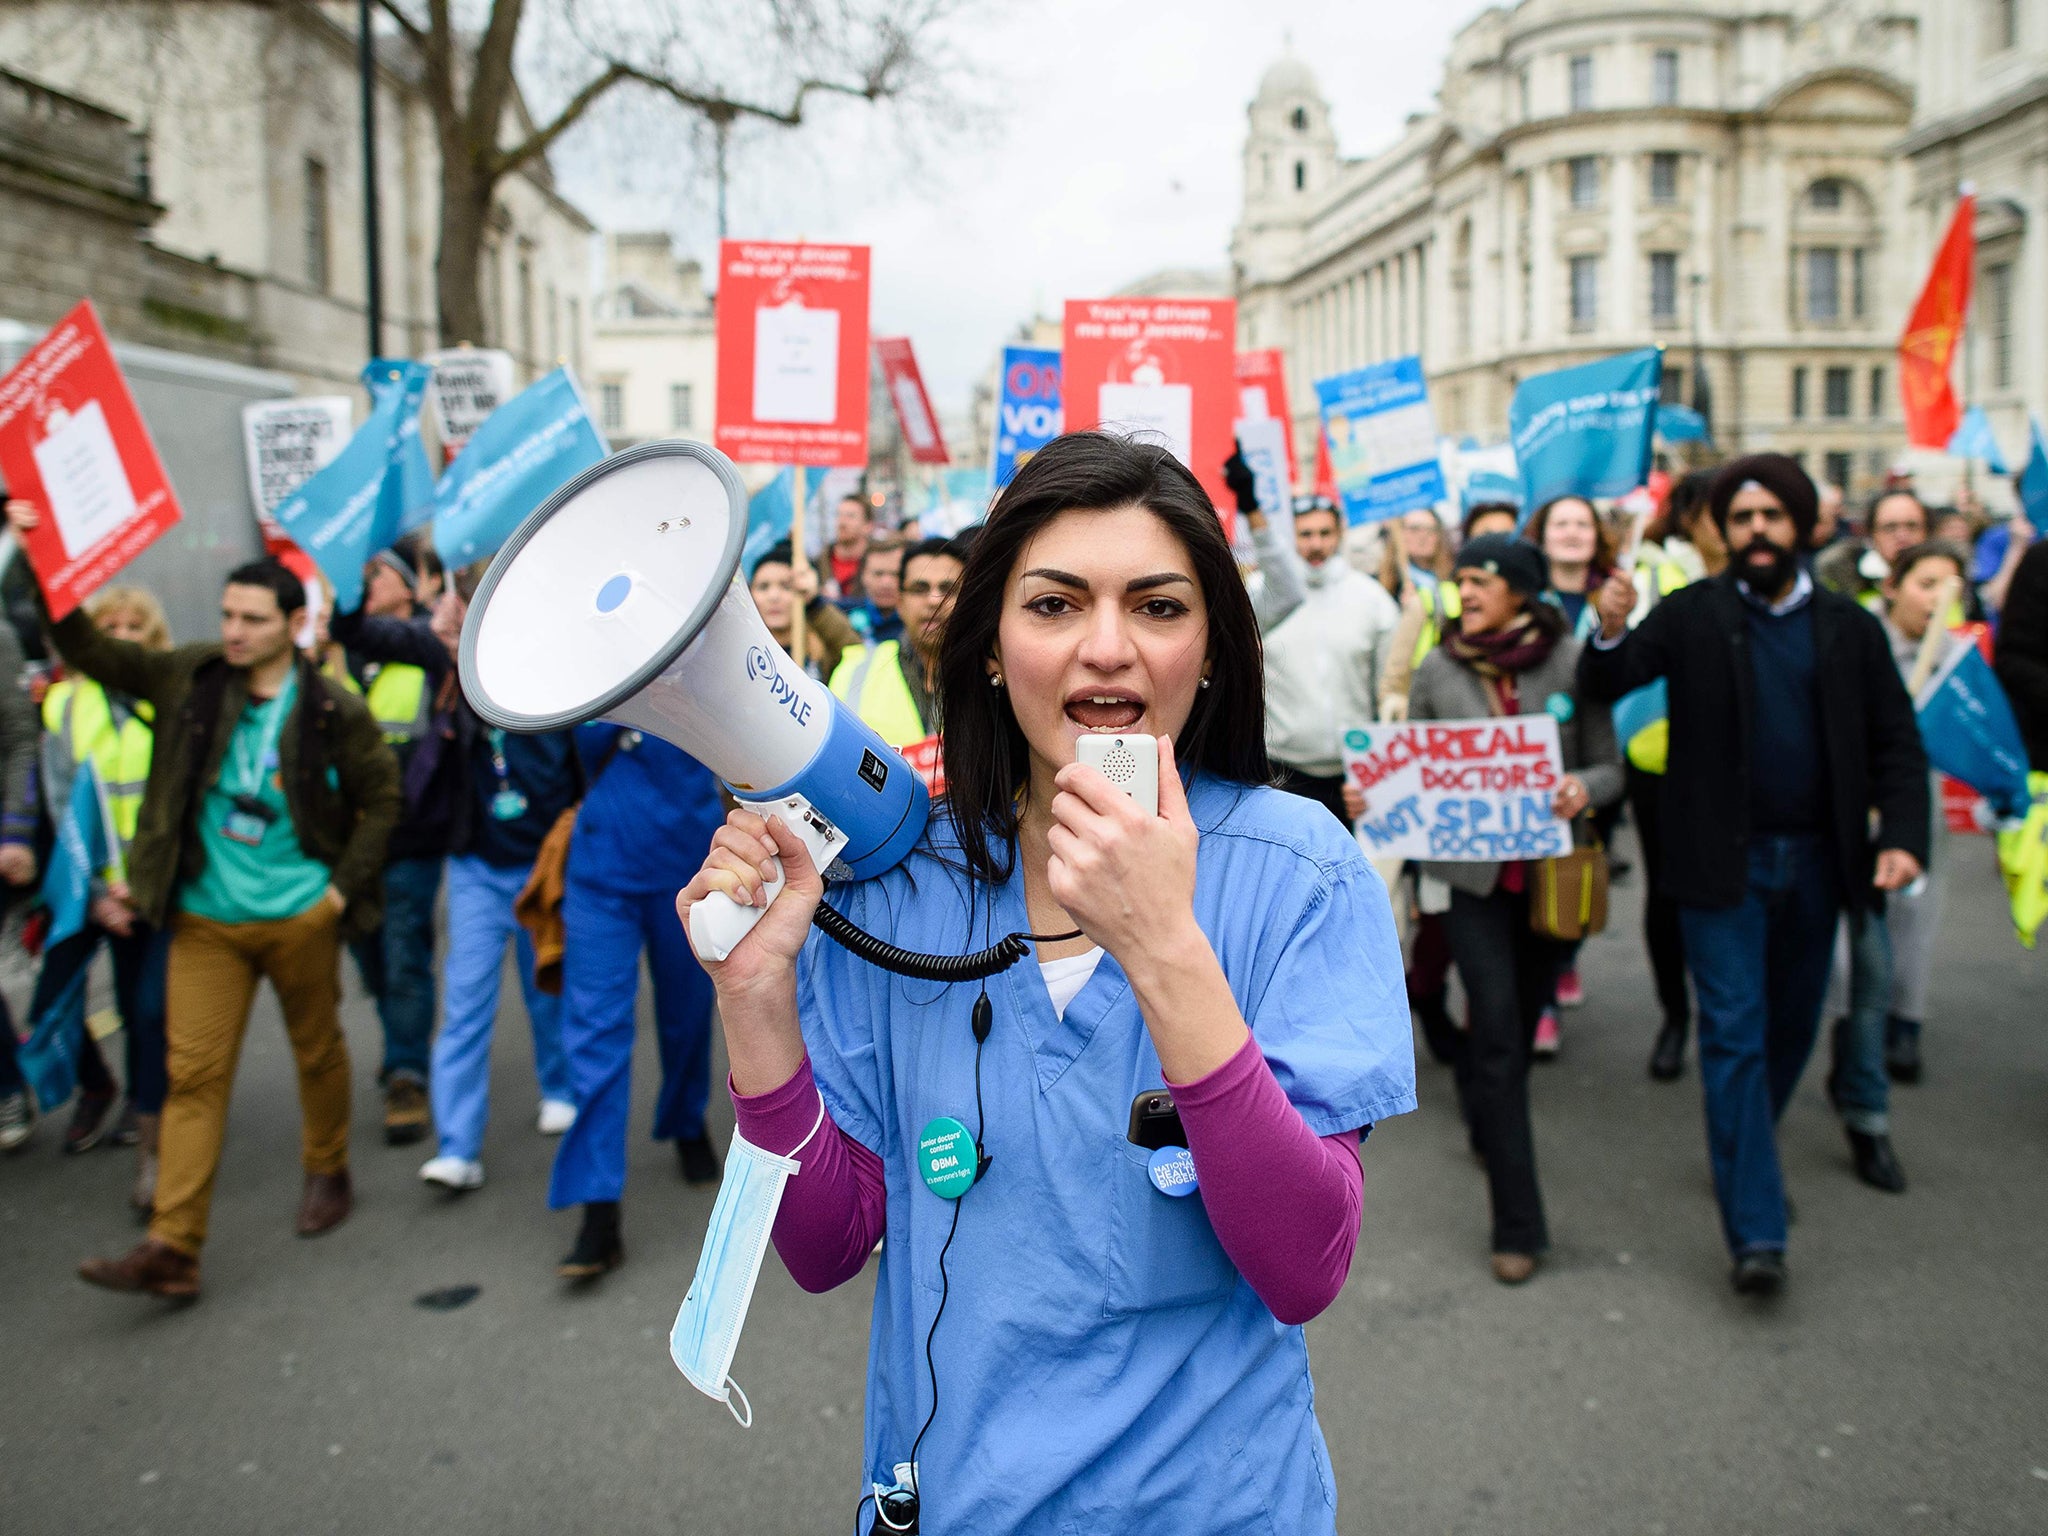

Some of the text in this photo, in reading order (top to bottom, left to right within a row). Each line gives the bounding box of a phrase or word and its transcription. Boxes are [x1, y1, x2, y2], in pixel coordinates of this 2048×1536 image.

[741, 246, 851, 264] You've driven
[729, 263, 755, 277] me
[757, 262, 787, 278] out
[1087, 303, 1211, 322] You've driven
[1074, 322, 1105, 339] me
[1107, 322, 1140, 339] out
[1351, 724, 1547, 790] BACK REAL
[1421, 760, 1557, 793] DOCTORS
[1363, 795, 1425, 848] NOT
[1429, 826, 1563, 856] DOCTORS
[929, 1141, 954, 1154] contract
[939, 1155, 959, 1169] BMA
[957, 1168, 971, 1178] fight
